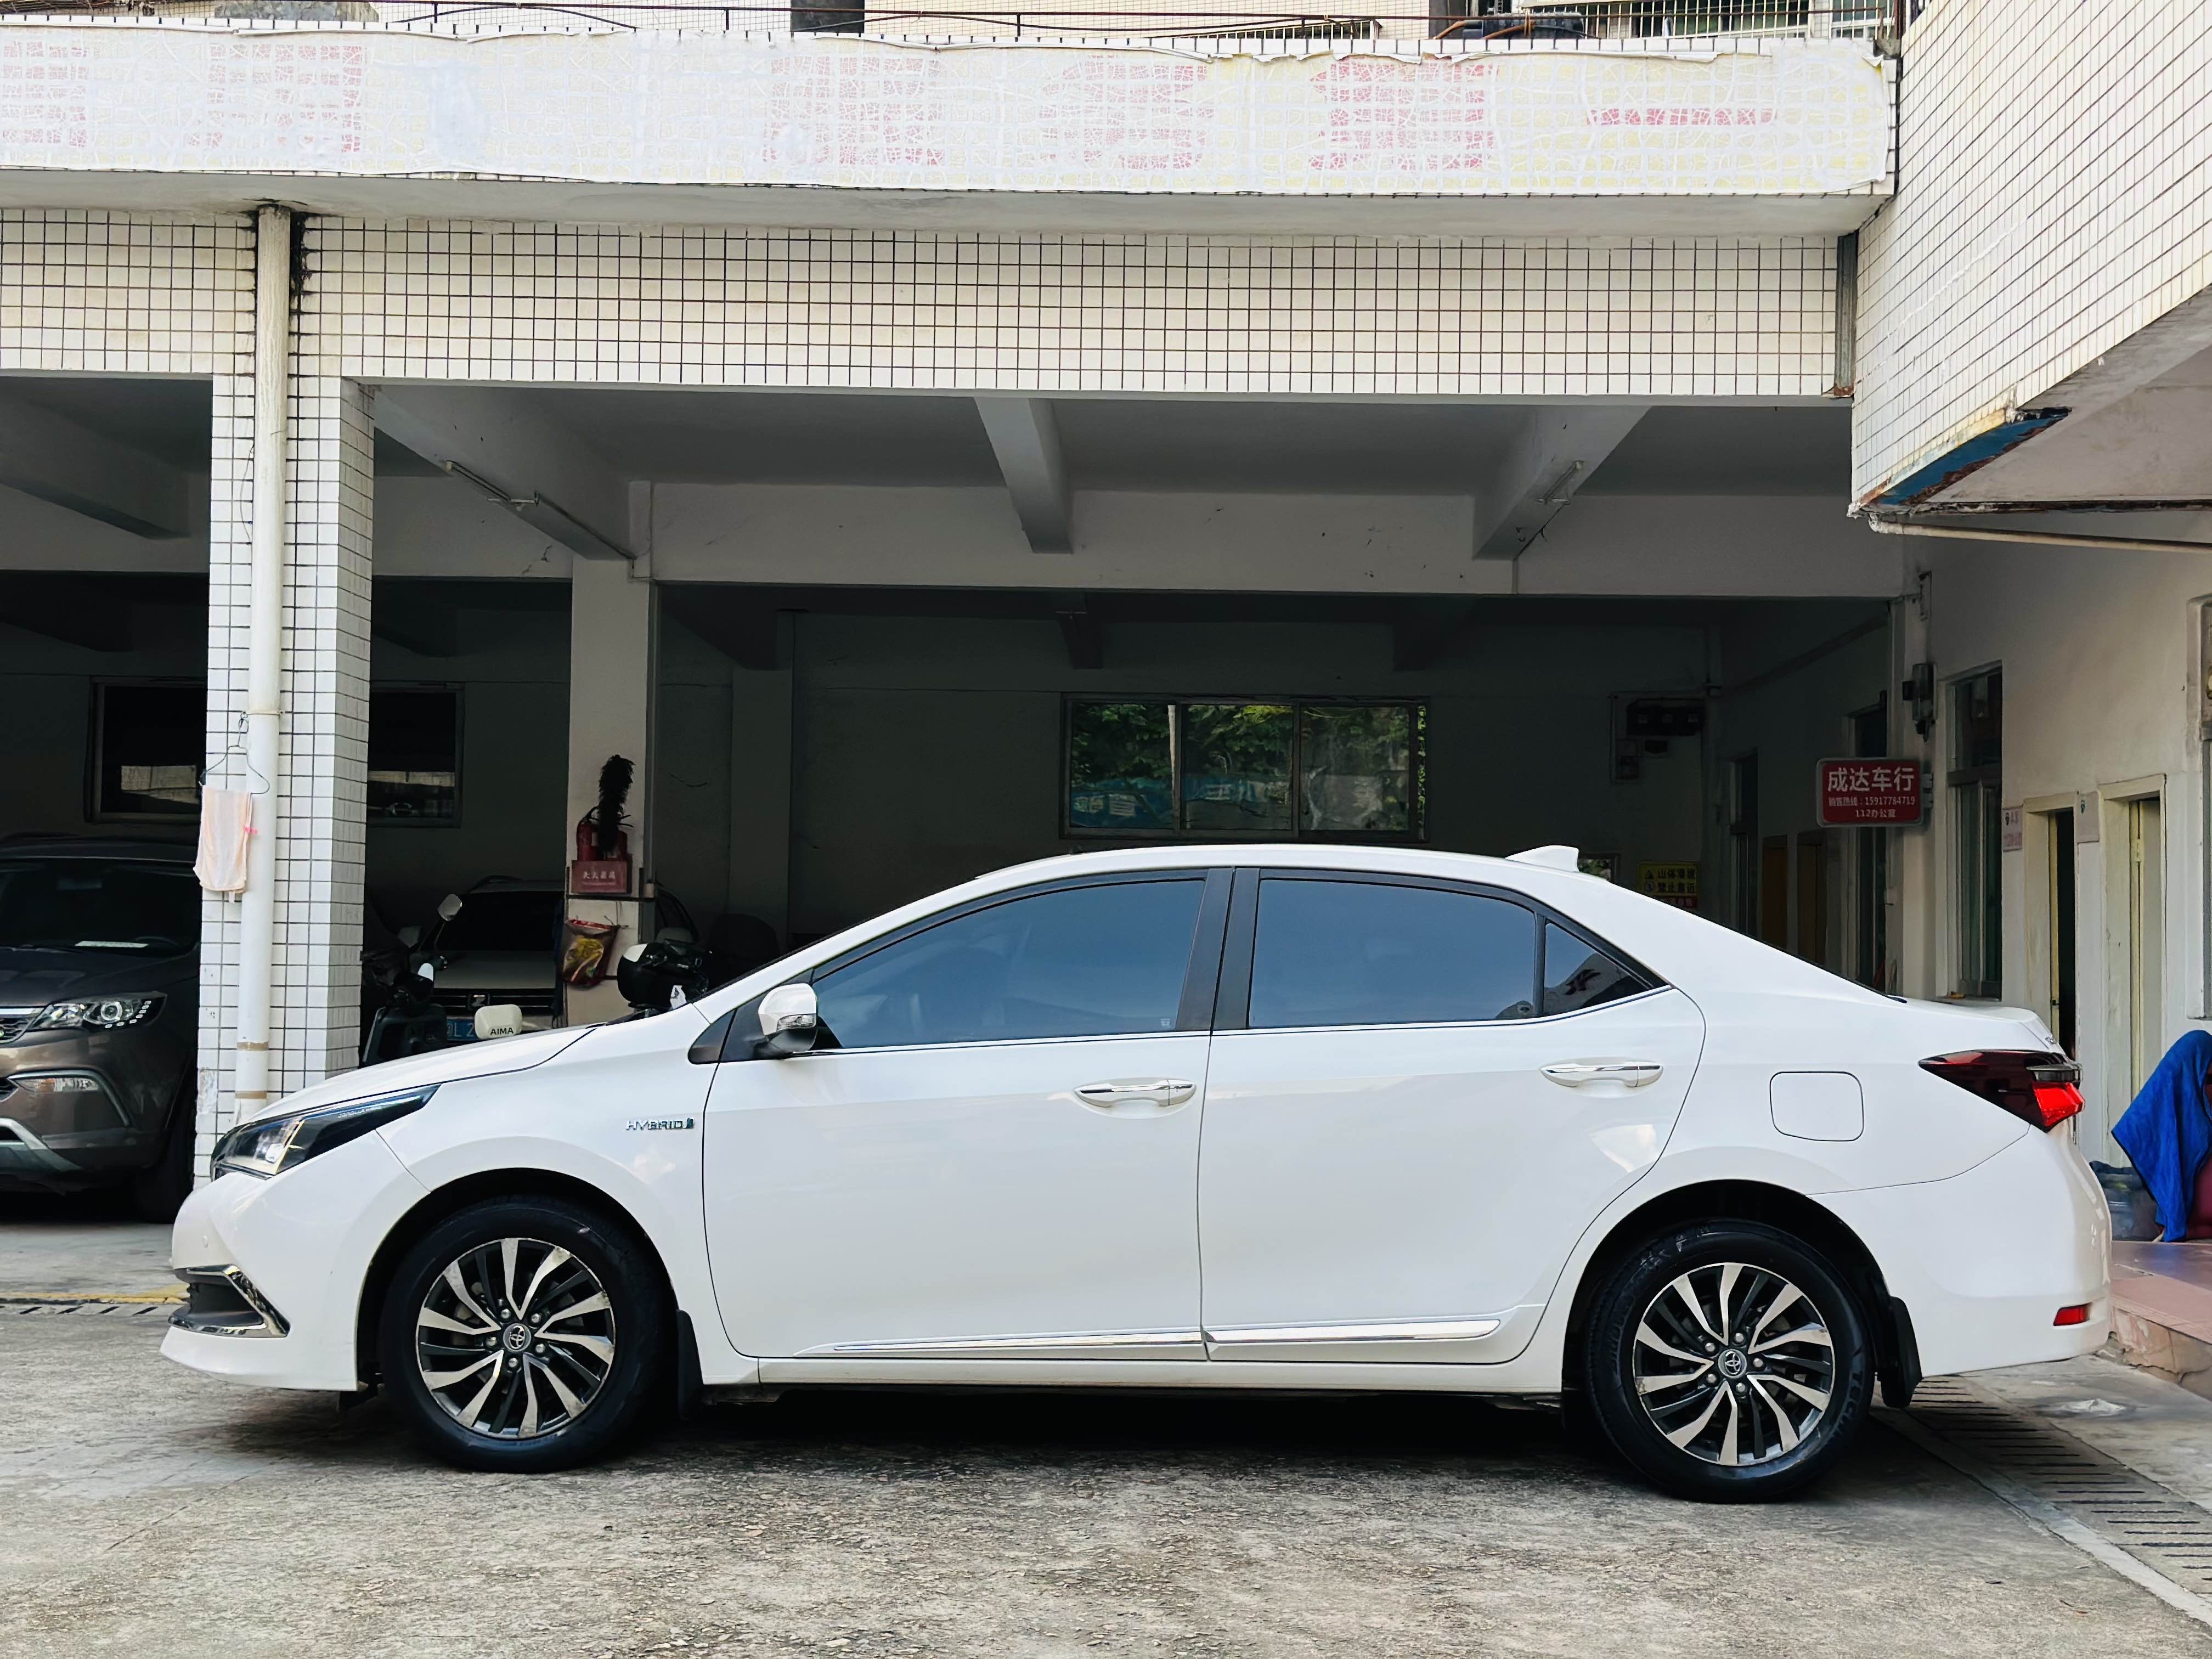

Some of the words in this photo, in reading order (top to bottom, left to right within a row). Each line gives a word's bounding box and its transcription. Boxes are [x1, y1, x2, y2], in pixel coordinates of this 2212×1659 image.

[1828, 767, 1915, 792] 成达车行
[1855, 809, 1897, 818] 112办公室
[490, 1027, 514, 1036] AIMA
[626, 1119, 684, 1131] HYBRID
